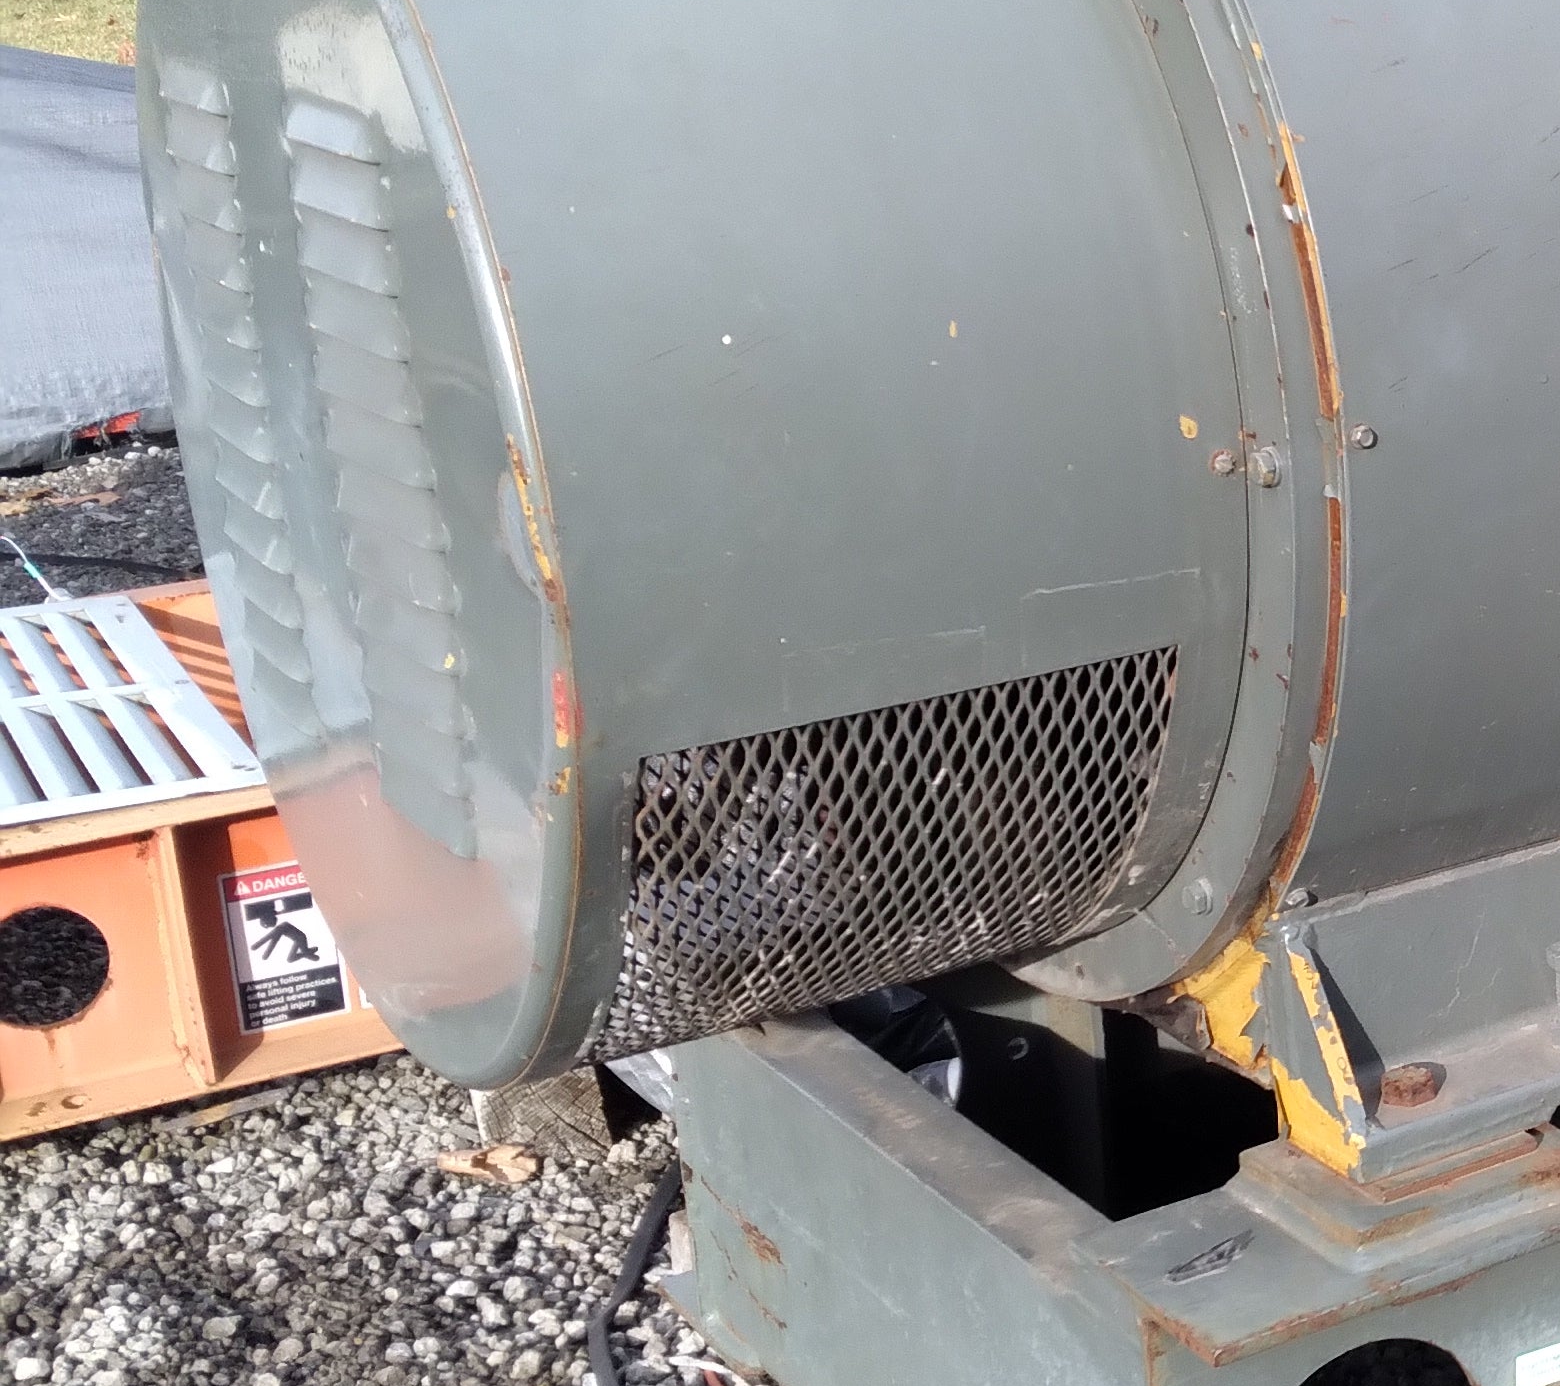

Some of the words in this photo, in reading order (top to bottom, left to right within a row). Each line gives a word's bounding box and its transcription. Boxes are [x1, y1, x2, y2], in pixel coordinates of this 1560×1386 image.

[252, 871, 307, 893] DANGE
[246, 978, 279, 992] Always
[280, 973, 308, 985] follow
[247, 989, 266, 1001] safe
[268, 984, 294, 997] lifting
[295, 976, 337, 992] practices
[259, 996, 285, 1008] avoid
[286, 990, 316, 1001] severe
[249, 1004, 289, 1020] personal
[290, 999, 316, 1010] injury
[262, 1014, 288, 1025] death
